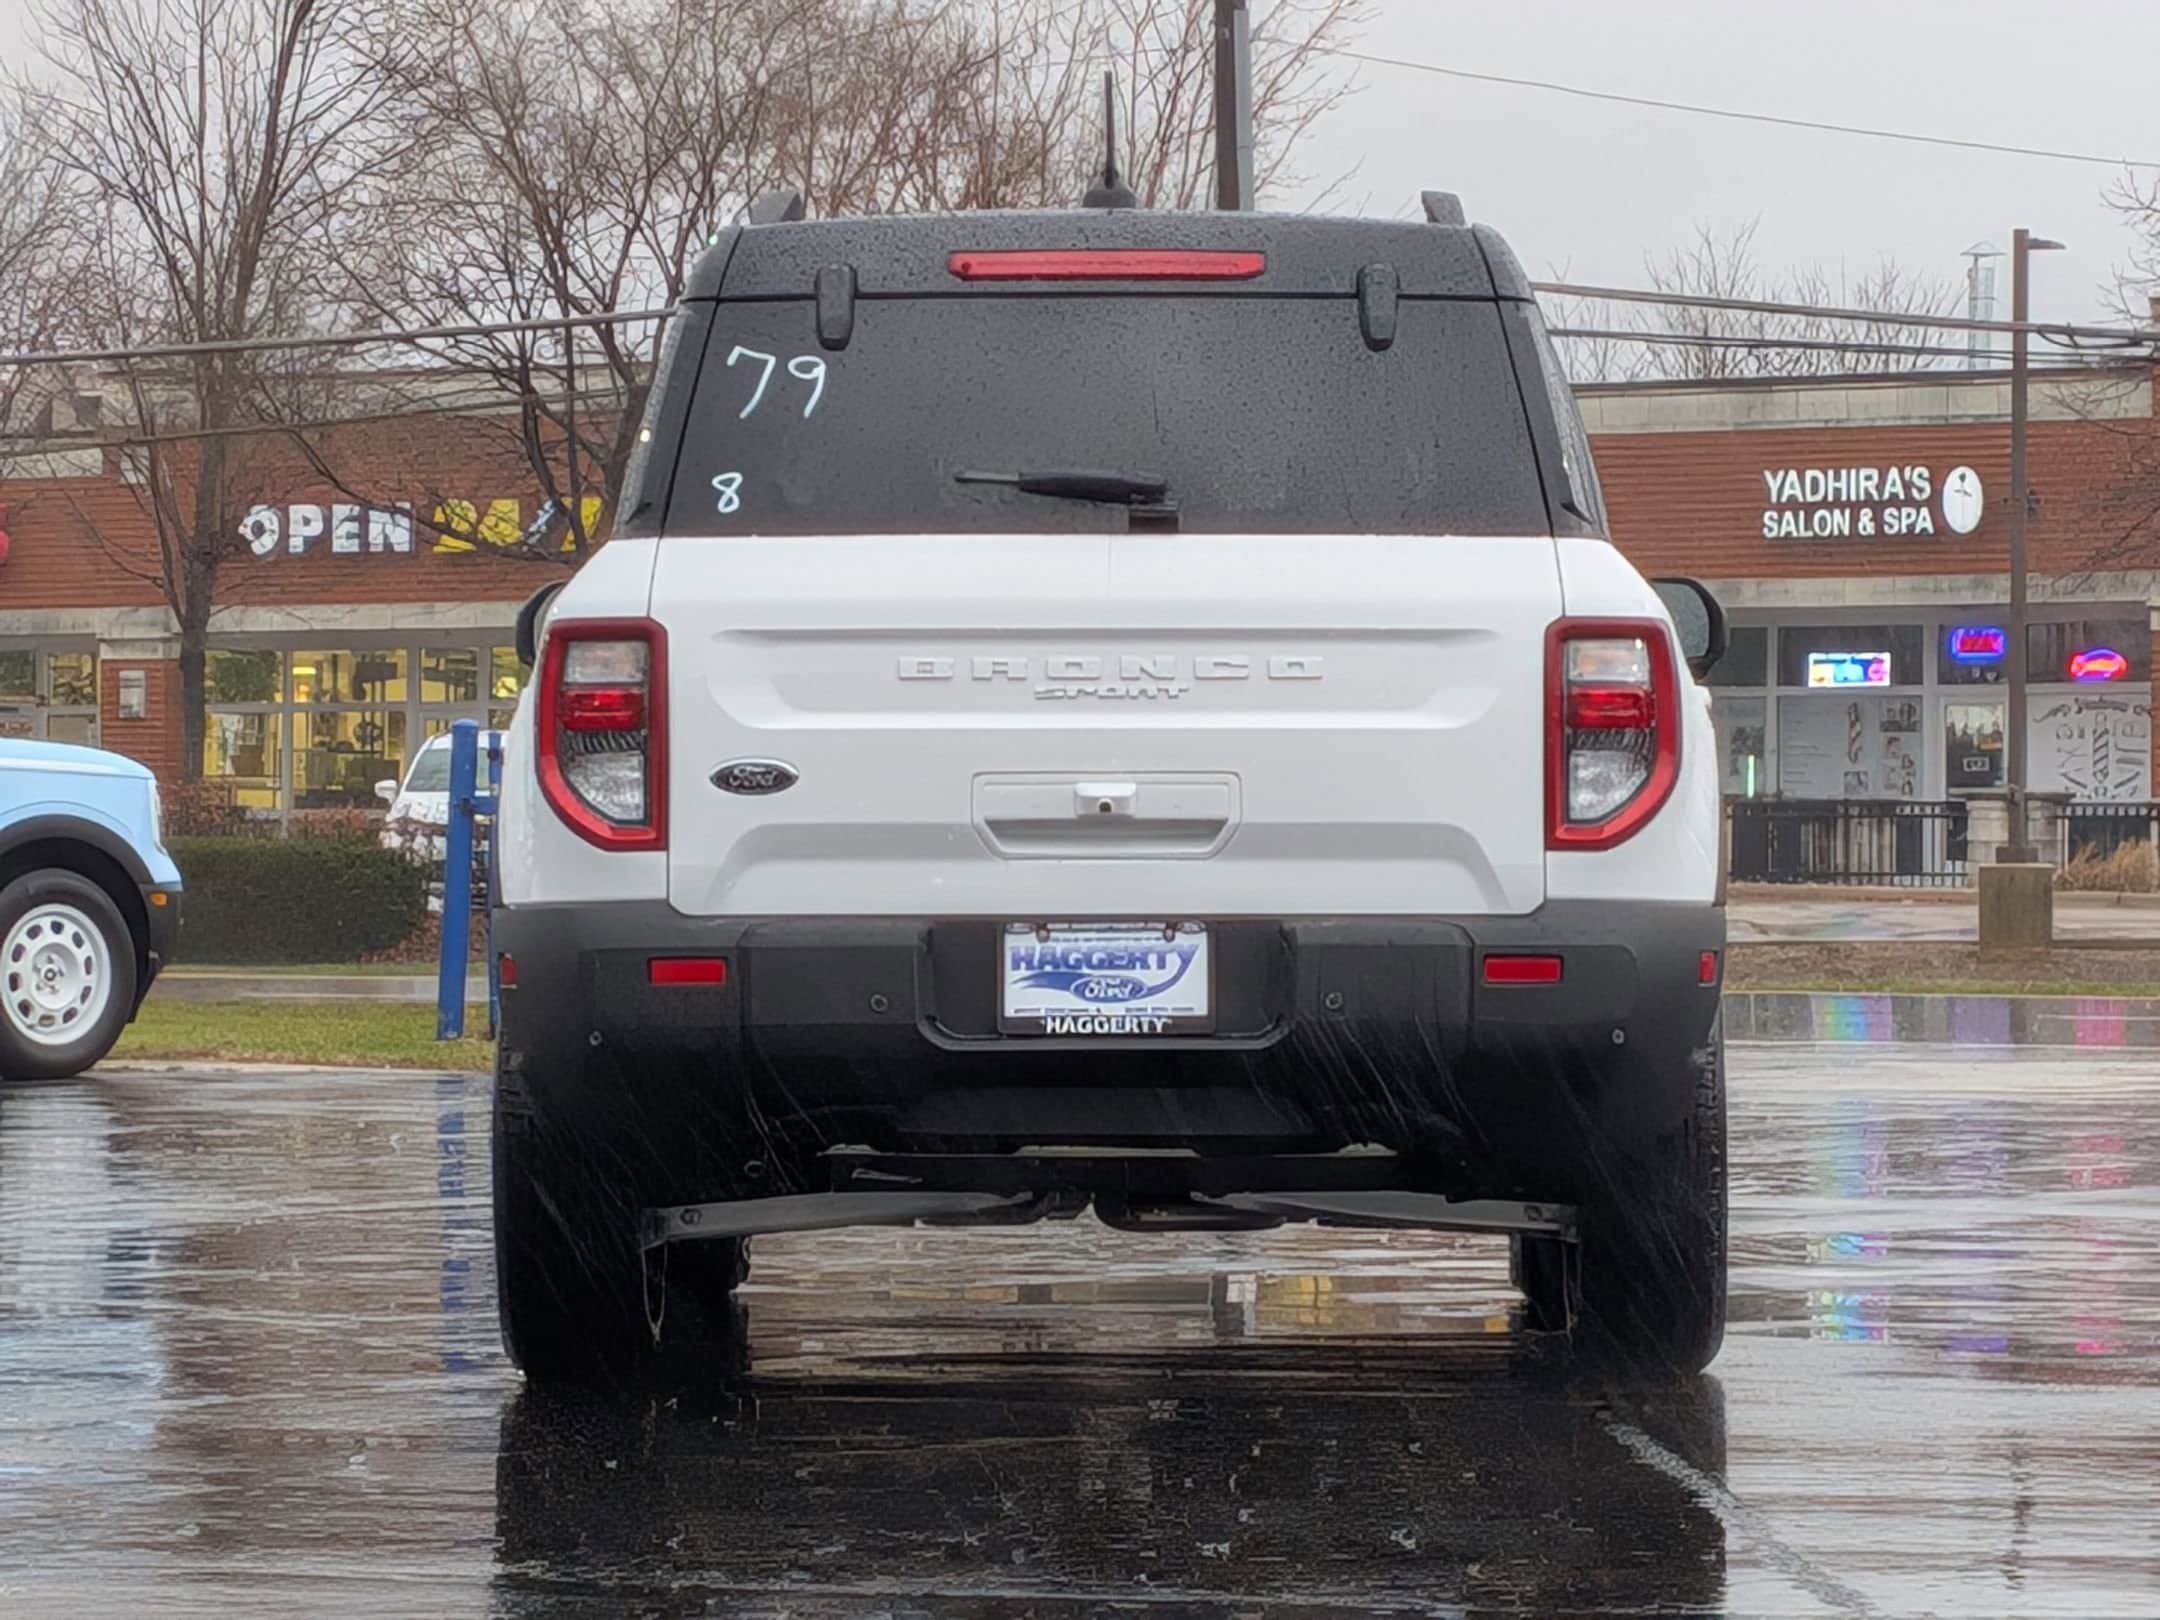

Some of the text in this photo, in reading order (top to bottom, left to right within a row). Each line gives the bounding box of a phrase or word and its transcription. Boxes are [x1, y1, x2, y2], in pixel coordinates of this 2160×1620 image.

[726, 345, 829, 421] 79
[711, 471, 742, 515] 8
[1762, 465, 1932, 504] YADHIRA'S
[238, 501, 413, 557] OPEN
[1762, 507, 1935, 539] SALON & SPA
[897, 655, 1325, 681] BRONCO
[1034, 683, 1190, 702] SPORT
[727, 763, 783, 790] Ford
[1009, 943, 1202, 973] HAGGERTY
[1083, 975, 1134, 999] Ford
[1045, 1015, 1167, 1035] HAGGERTY
